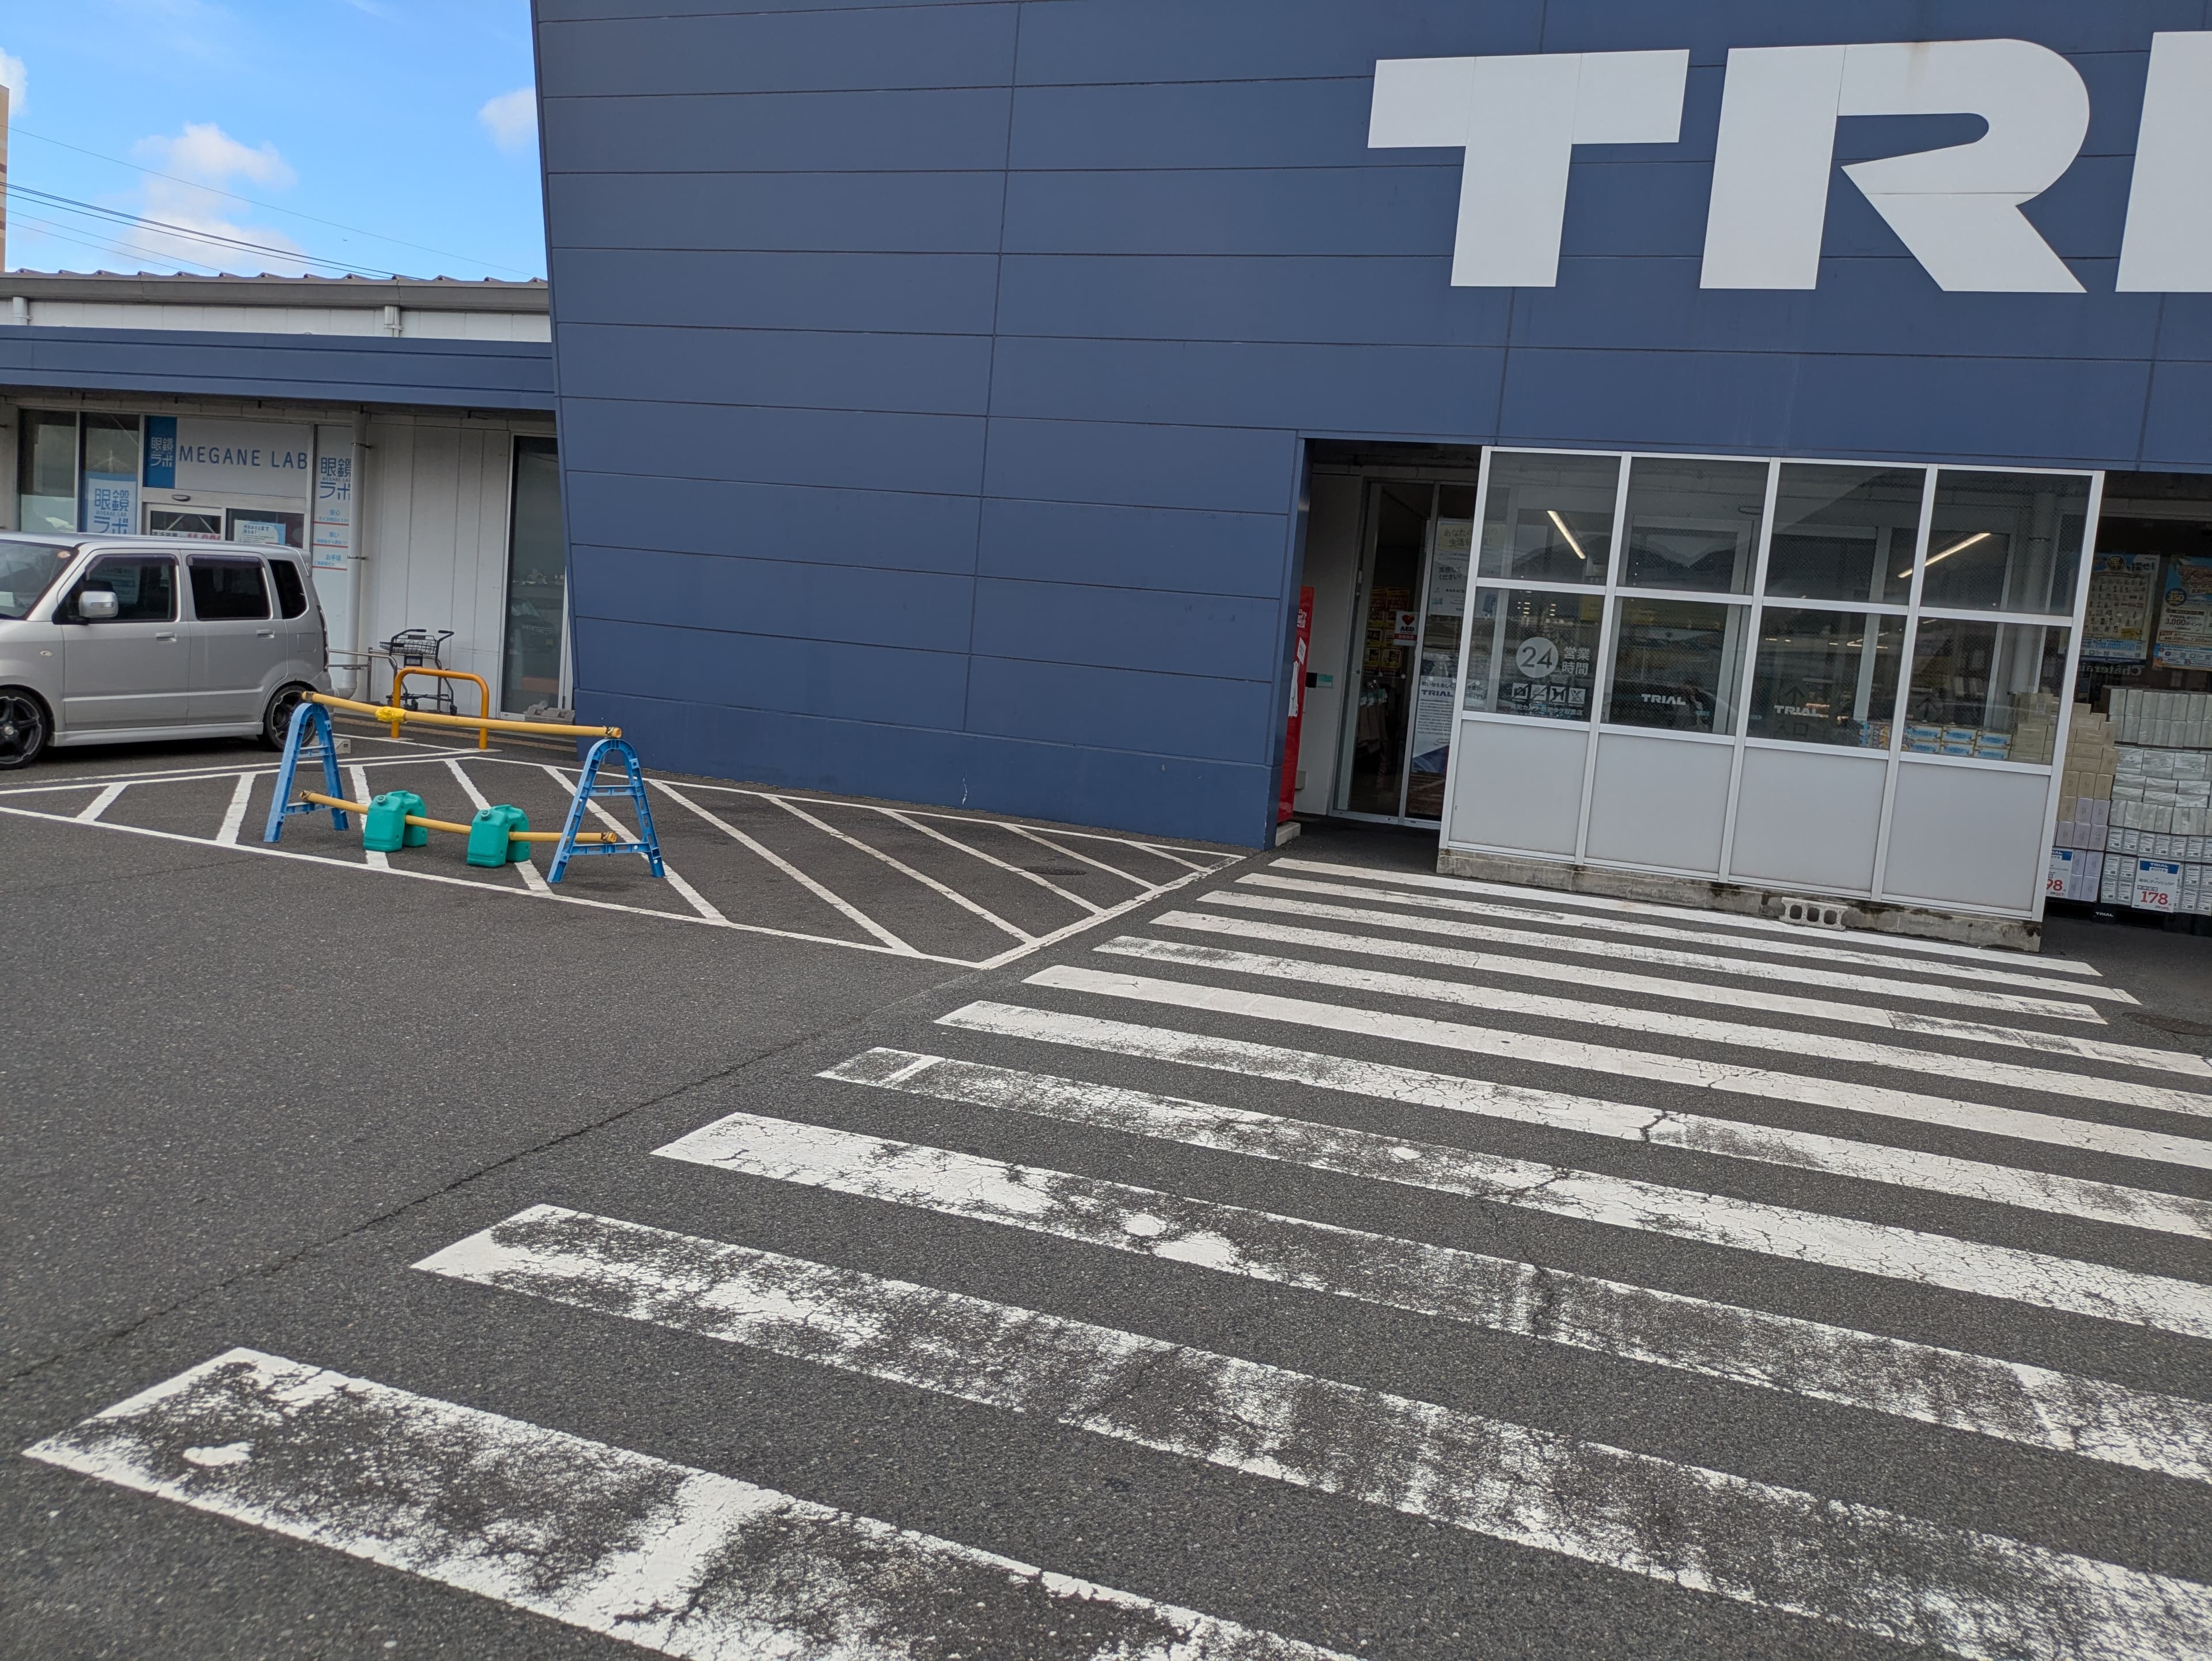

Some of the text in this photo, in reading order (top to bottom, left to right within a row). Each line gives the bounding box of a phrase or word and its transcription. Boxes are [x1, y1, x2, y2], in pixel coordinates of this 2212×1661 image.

[150, 437, 173, 452] 眼鏡
[150, 453, 173, 468] ラボ
[179, 445, 308, 470] MEGANE LAB
[94, 488, 130, 512] 眼鏡
[1521, 645, 1553, 669] 24
[1563, 645, 1590, 661] 営業
[1561, 661, 1589, 676] 時間
[1421, 689, 1454, 698] TRIAL
[1641, 693, 1686, 705] TRIAL
[1774, 705, 1821, 717] TRIAL
[2141, 891, 2169, 906] 178
